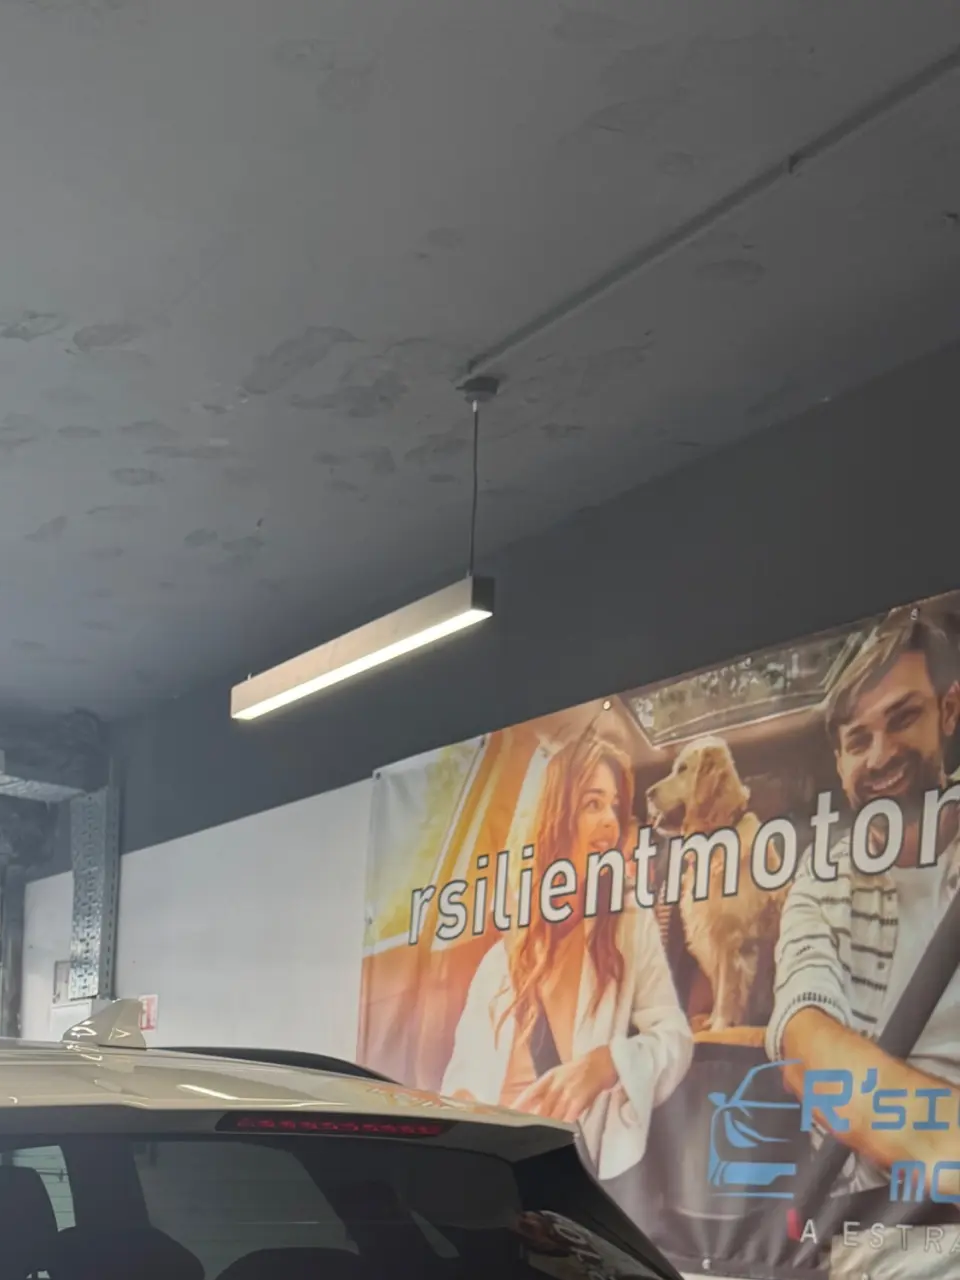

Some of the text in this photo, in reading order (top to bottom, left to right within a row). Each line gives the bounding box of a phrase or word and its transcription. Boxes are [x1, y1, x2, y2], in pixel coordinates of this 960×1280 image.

[408, 783, 960, 946] rsilientmotor
[800, 1068, 960, 1132] R'SI
[800, 1219, 818, 1244] A
